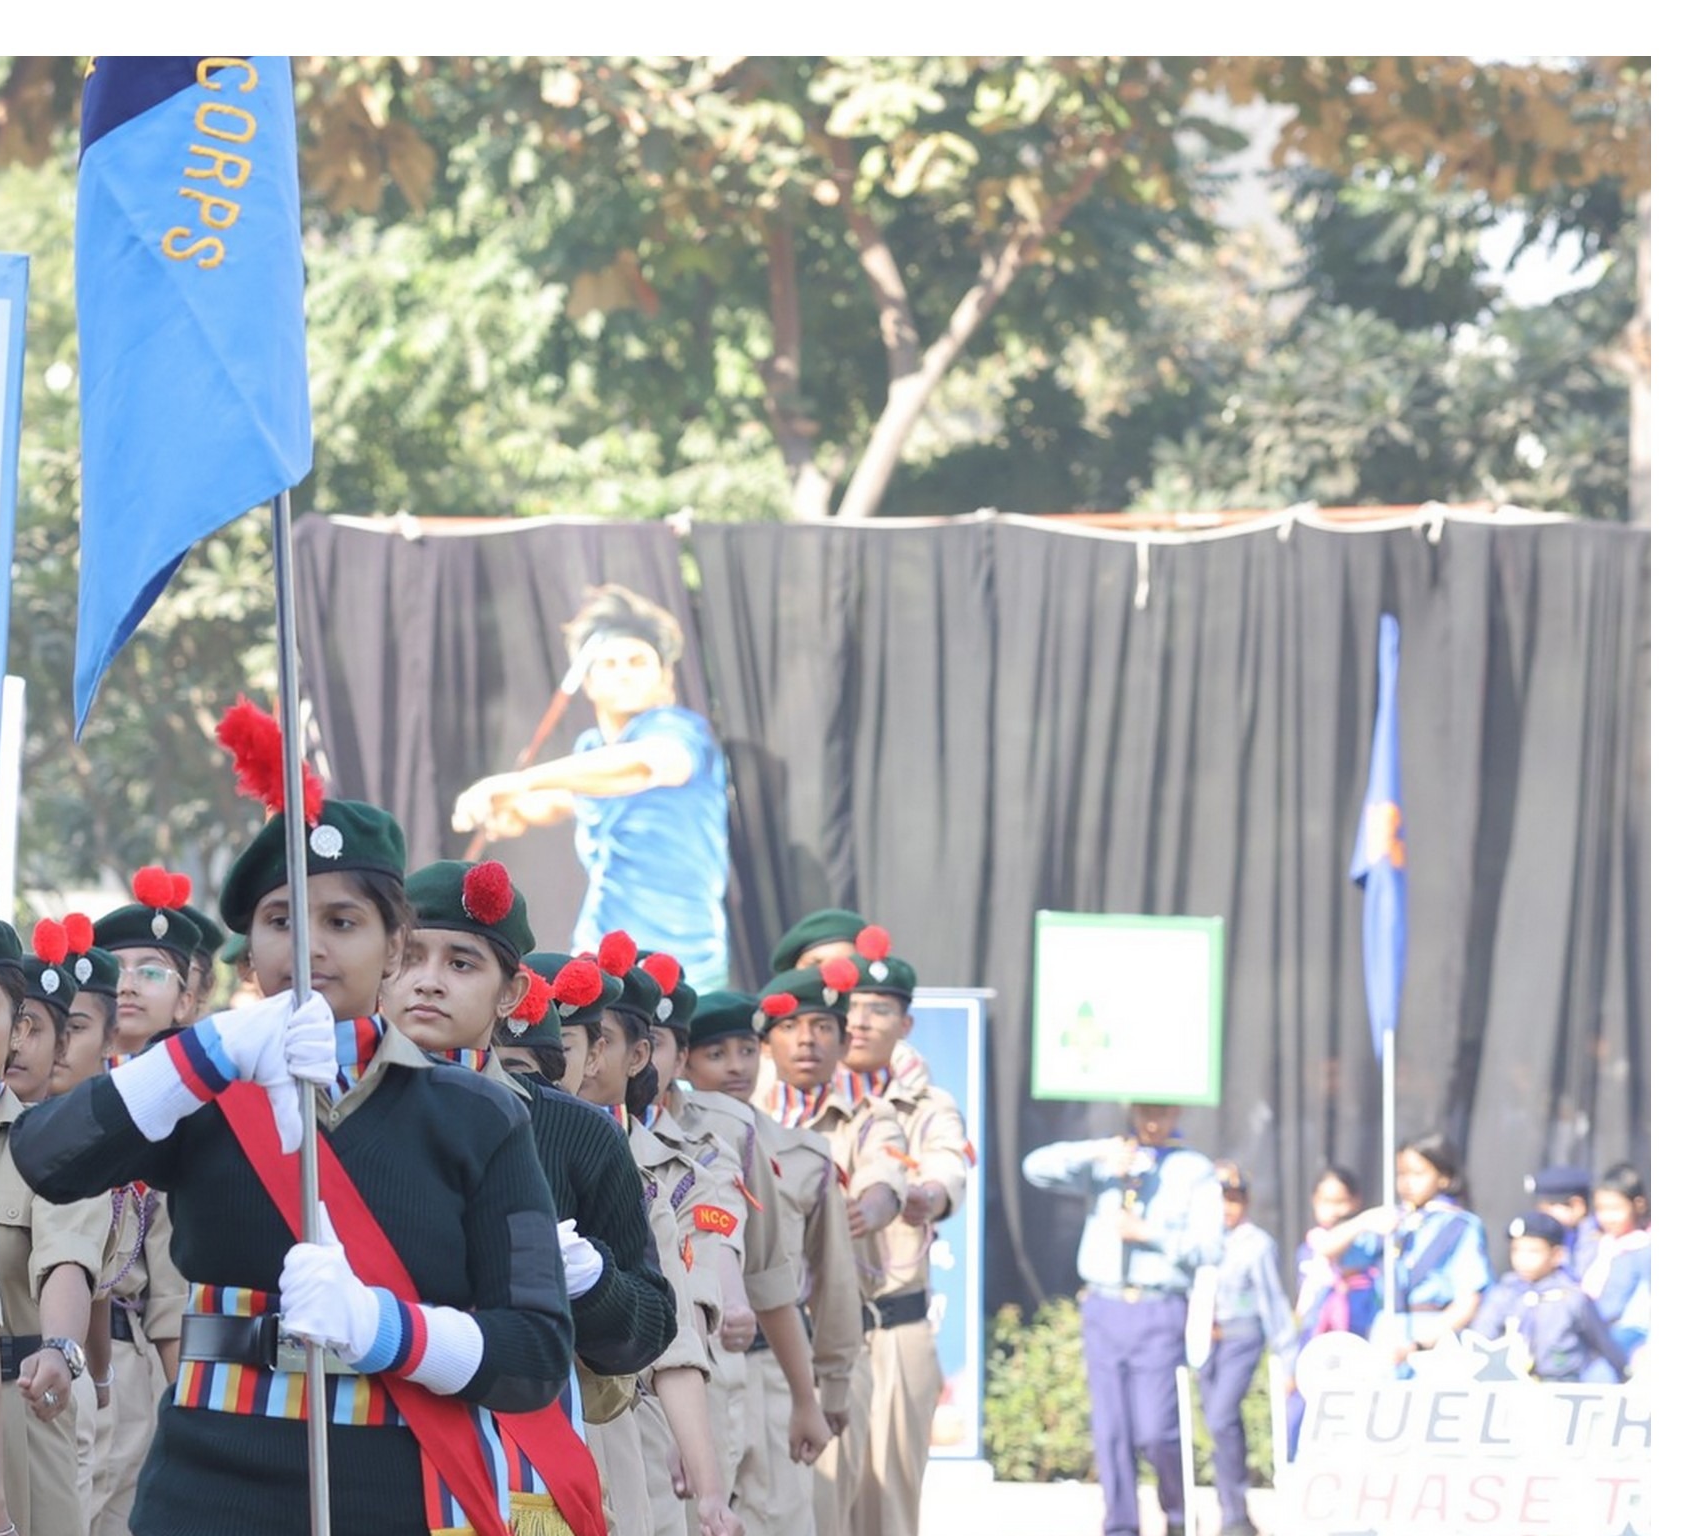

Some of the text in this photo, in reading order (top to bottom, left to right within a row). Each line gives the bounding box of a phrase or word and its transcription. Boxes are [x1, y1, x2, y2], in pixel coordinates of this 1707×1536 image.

[161, 56, 258, 269] CORPS
[700, 1208, 729, 1228] NCC
[1311, 1390, 1512, 1444] FUEL
[1302, 1472, 1560, 1524] CHASE
